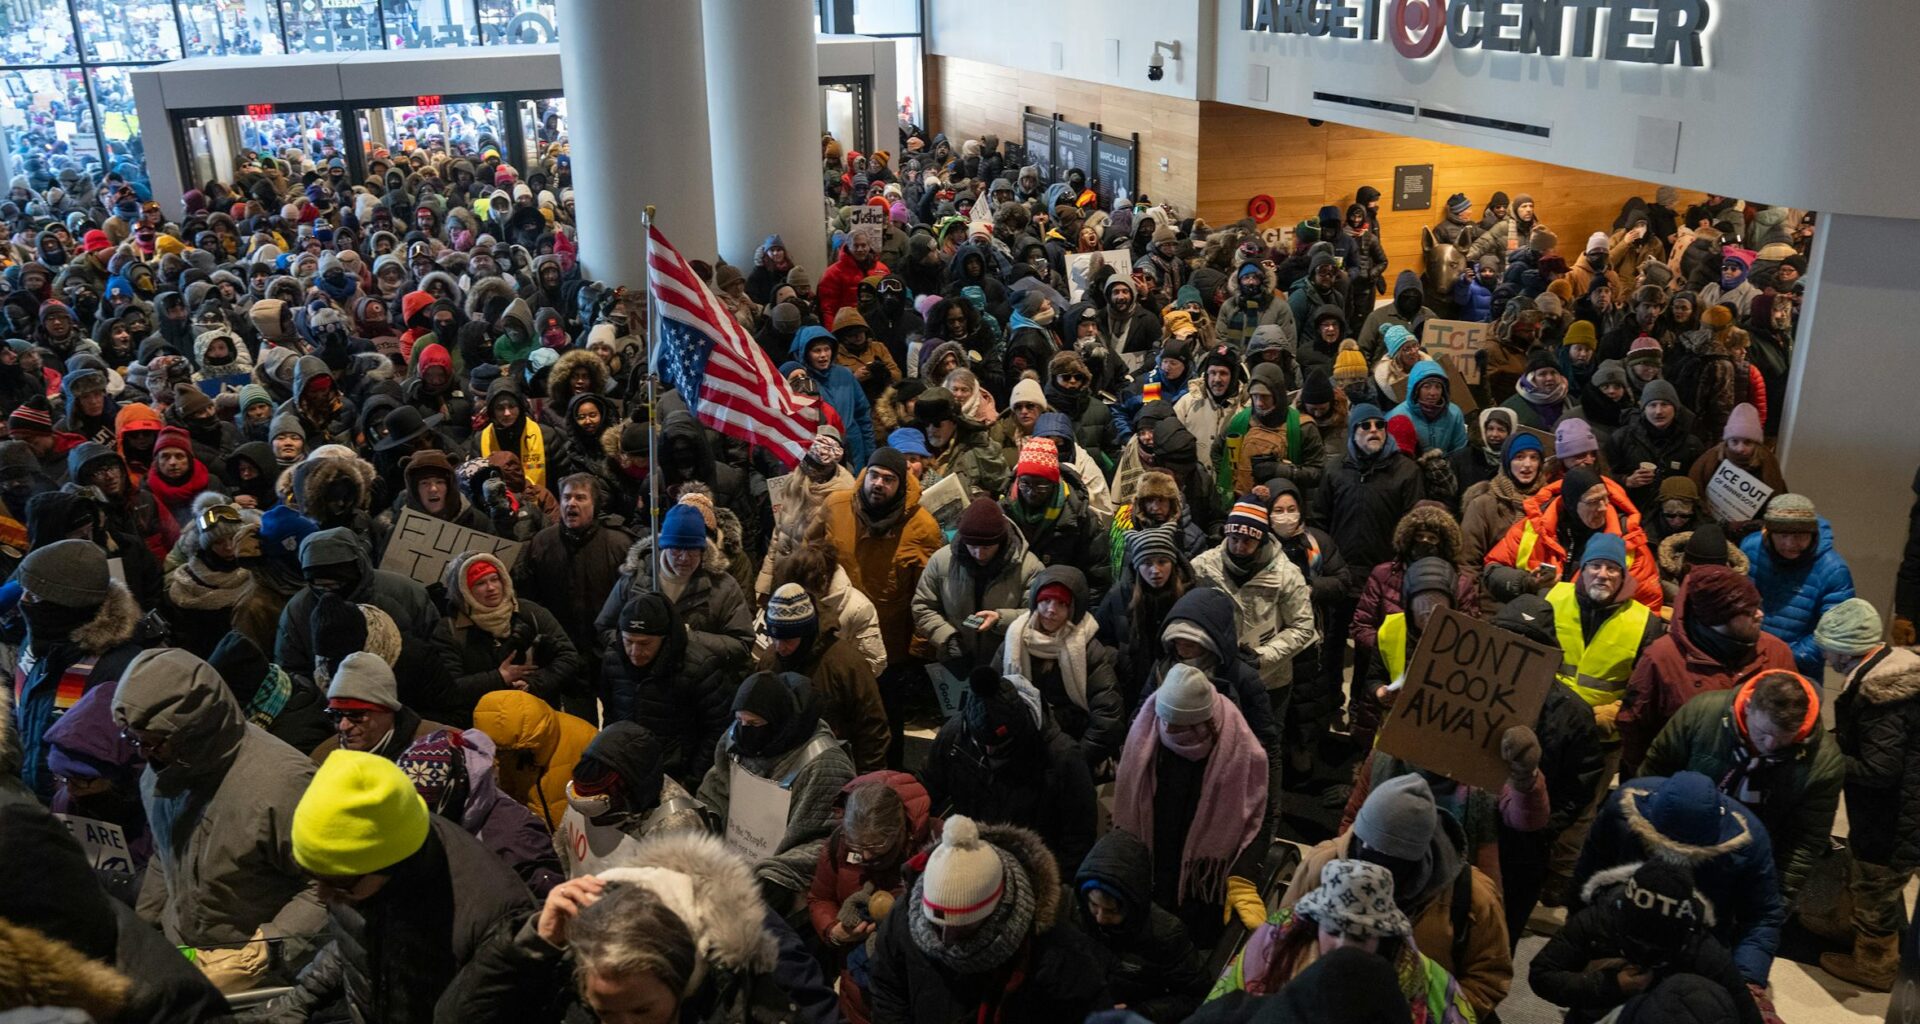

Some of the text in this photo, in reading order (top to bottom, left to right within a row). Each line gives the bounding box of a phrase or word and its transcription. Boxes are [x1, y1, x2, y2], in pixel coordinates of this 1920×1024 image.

[1445, 0, 1709, 67] CENTER
[247, 104, 273, 116] EXIT
[415, 95, 441, 106] EXIT
[1425, 324, 1481, 351] ICE
[1714, 477, 1724, 485] OF
[1722, 483, 1758, 510] MINNESOTA
[1718, 466, 1767, 502] ICE OUT
[1430, 614, 1545, 686] DONT
[1423, 659, 1516, 714] LOOK
[1400, 687, 1505, 749] AWAY
[86, 823, 124, 850] ARE
